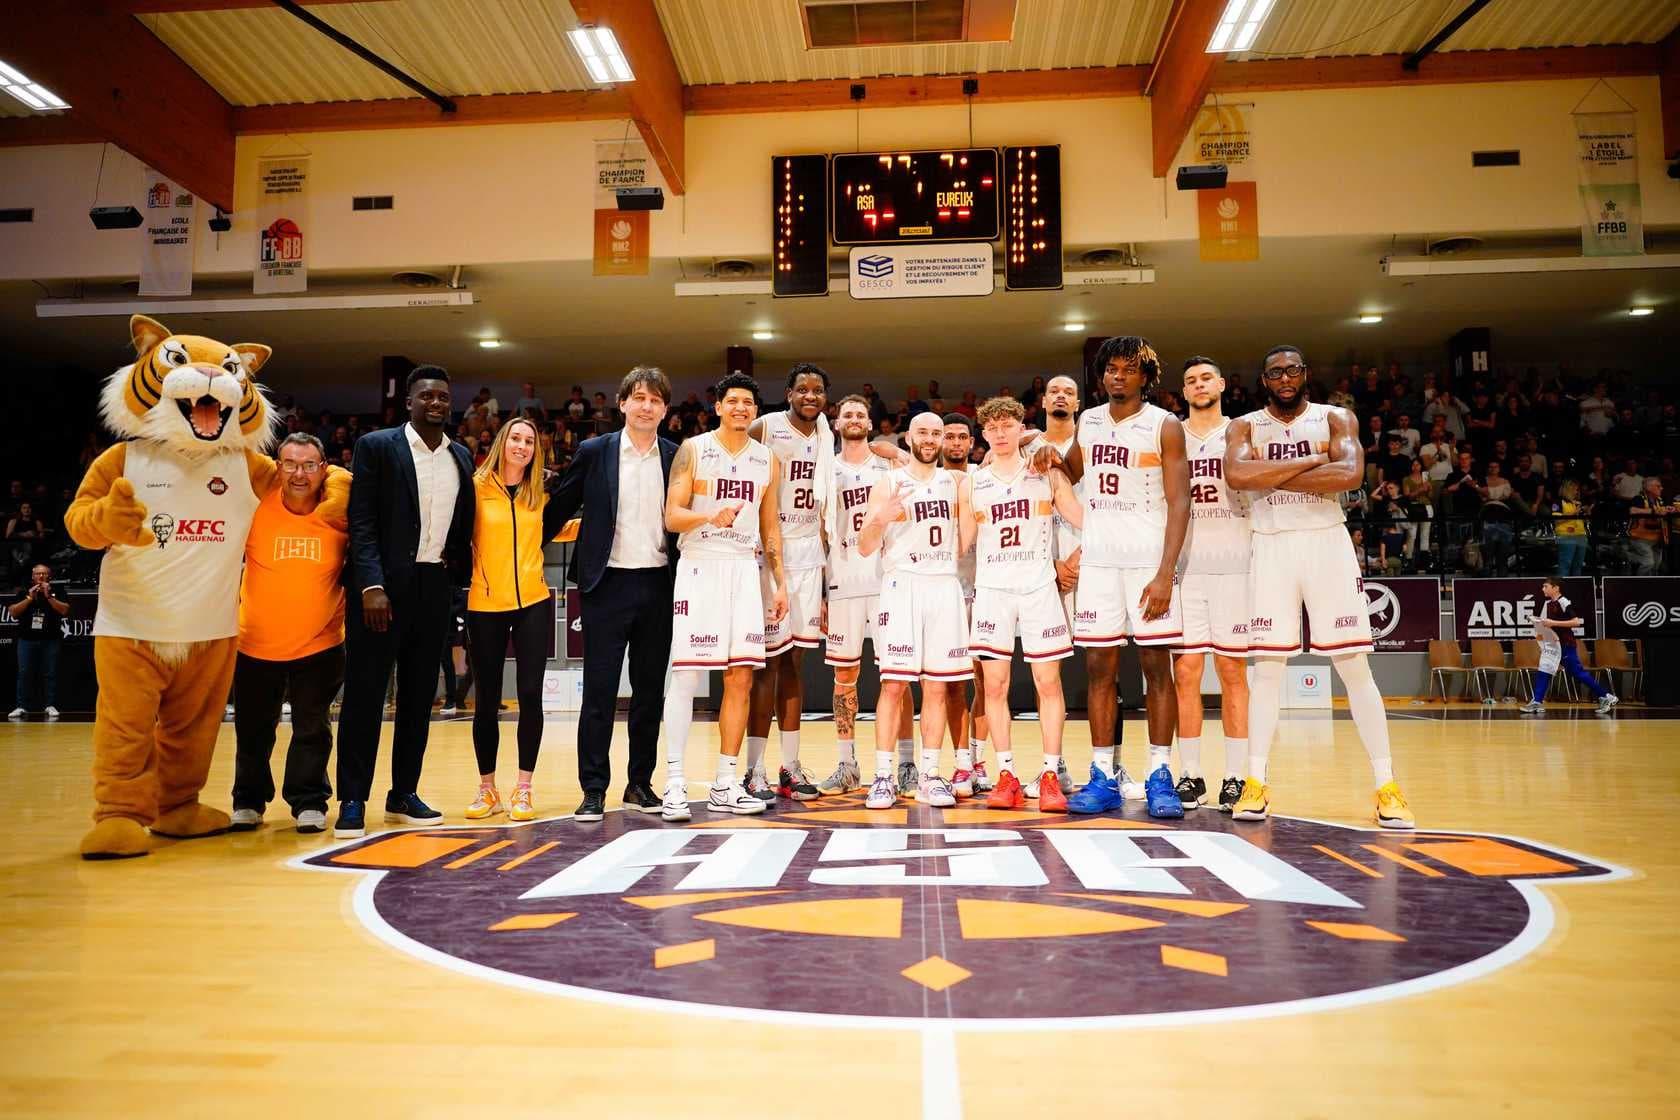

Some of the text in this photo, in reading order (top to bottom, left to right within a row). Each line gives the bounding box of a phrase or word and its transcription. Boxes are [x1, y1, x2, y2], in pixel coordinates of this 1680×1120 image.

[1201, 141, 1250, 150] CHAMPION
[1201, 147, 1250, 157] DE FRANCE
[600, 168, 646, 178] CHAMPION
[600, 175, 646, 185] DE FRANCE
[857, 195, 875, 211] ASA
[936, 191, 974, 208] EVREUX
[180, 227, 190, 235] DE
[1598, 222, 1627, 234] FFBB
[261, 236, 303, 261] FFBB
[859, 279, 893, 289] GESCO
[1472, 351, 1488, 372] H
[386, 378, 396, 398] J
[1092, 444, 1129, 470] ASA
[1268, 439, 1312, 461] ASA
[789, 460, 816, 482] AS
[715, 478, 755, 503] ASA
[1098, 472, 1120, 496] 19
[1190, 484, 1219, 504] 42
[793, 488, 815, 510] 20
[852, 511, 867, 532] 6
[913, 499, 951, 523] ASA
[991, 498, 1030, 525] ASA
[176, 519, 226, 536] KFC
[929, 525, 943, 548] 0
[999, 525, 1021, 549] 21
[175, 535, 226, 543] HAGUENAU
[274, 536, 321, 562] ASA
[690, 634, 719, 643] Souffel
[520, 827, 1365, 909] ASA
